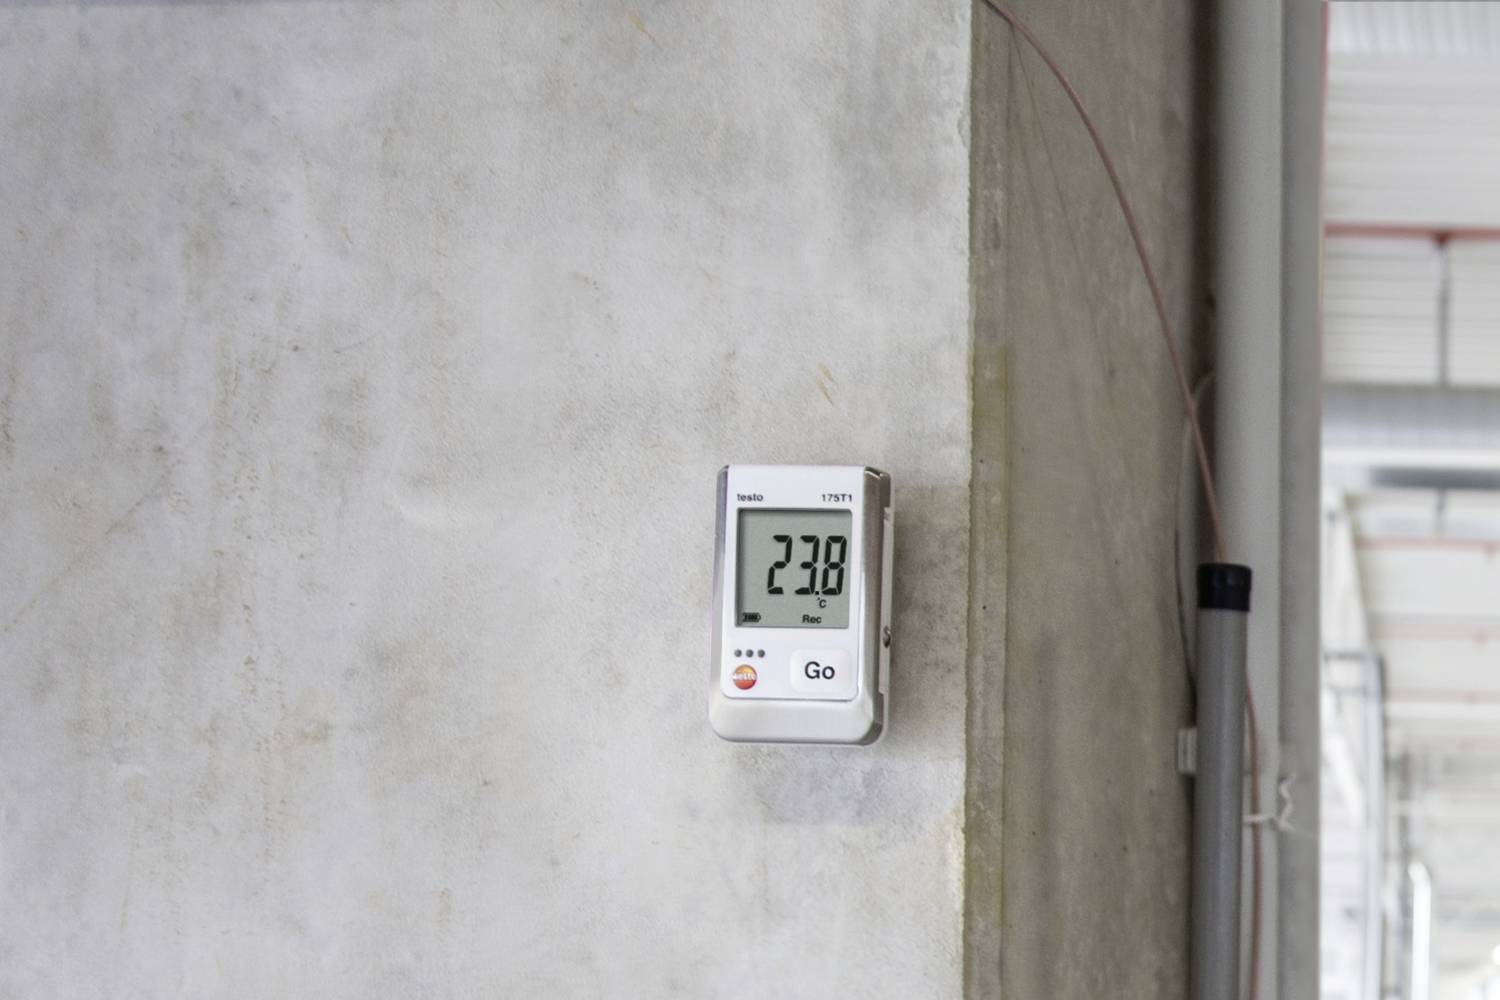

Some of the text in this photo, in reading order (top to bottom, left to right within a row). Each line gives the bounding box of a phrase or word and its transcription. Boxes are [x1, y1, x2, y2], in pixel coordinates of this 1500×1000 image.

[736, 493, 764, 502] testo
[821, 493, 853, 502] 175T1
[768, 535, 847, 595] 23.8
[802, 614, 822, 624] Rec
[804, 661, 836, 680] Go
